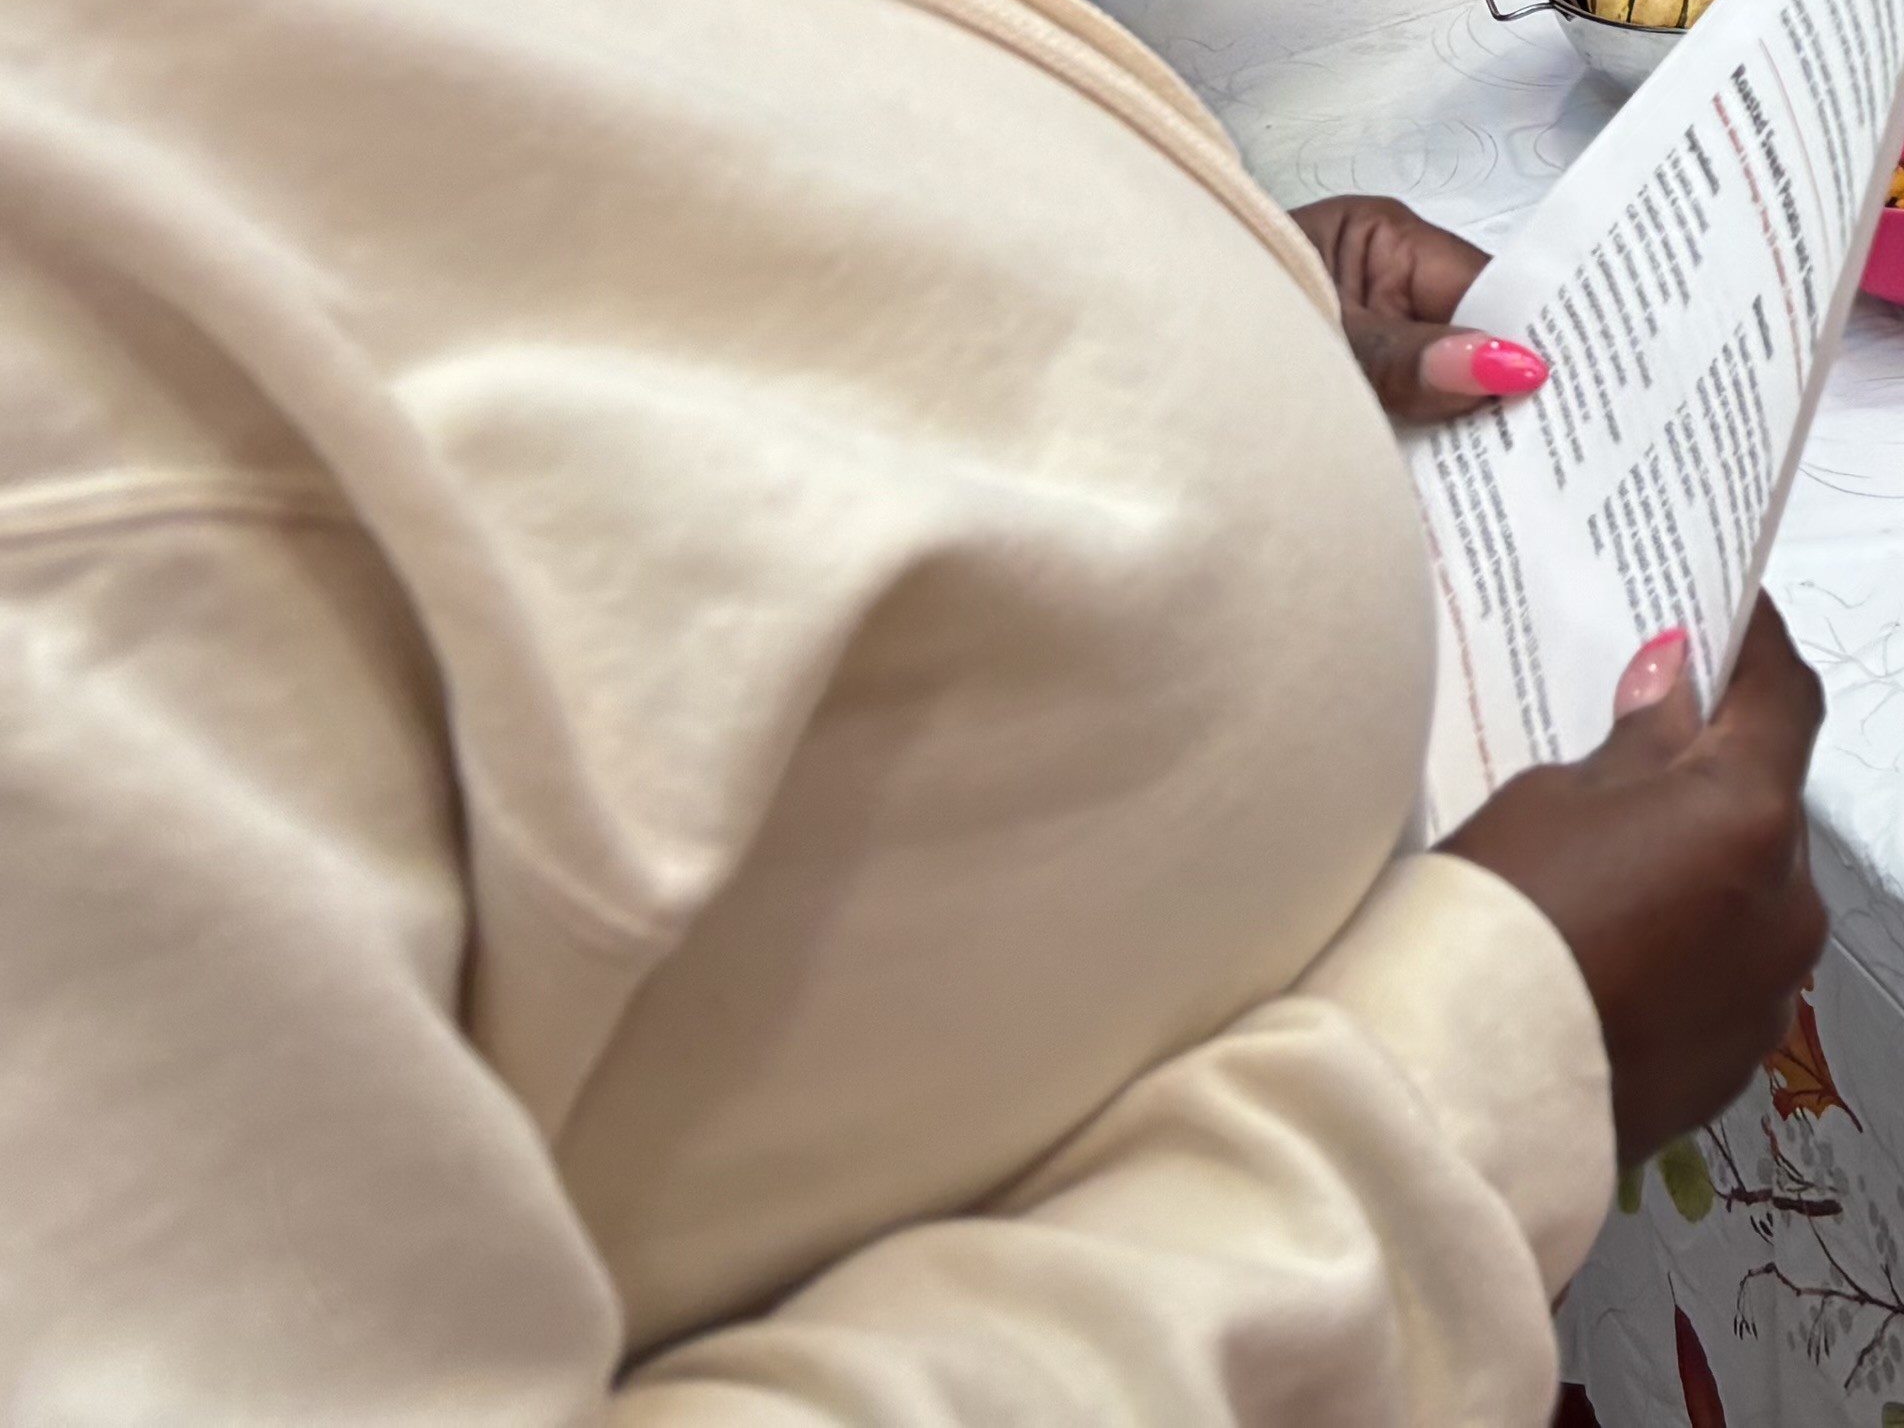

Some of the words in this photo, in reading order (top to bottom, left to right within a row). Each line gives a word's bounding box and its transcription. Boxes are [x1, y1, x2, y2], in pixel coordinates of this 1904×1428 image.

[1730, 64, 1768, 135] Roasted
[1760, 130, 1784, 184] Sweet
[1778, 179, 1800, 239] Potato
